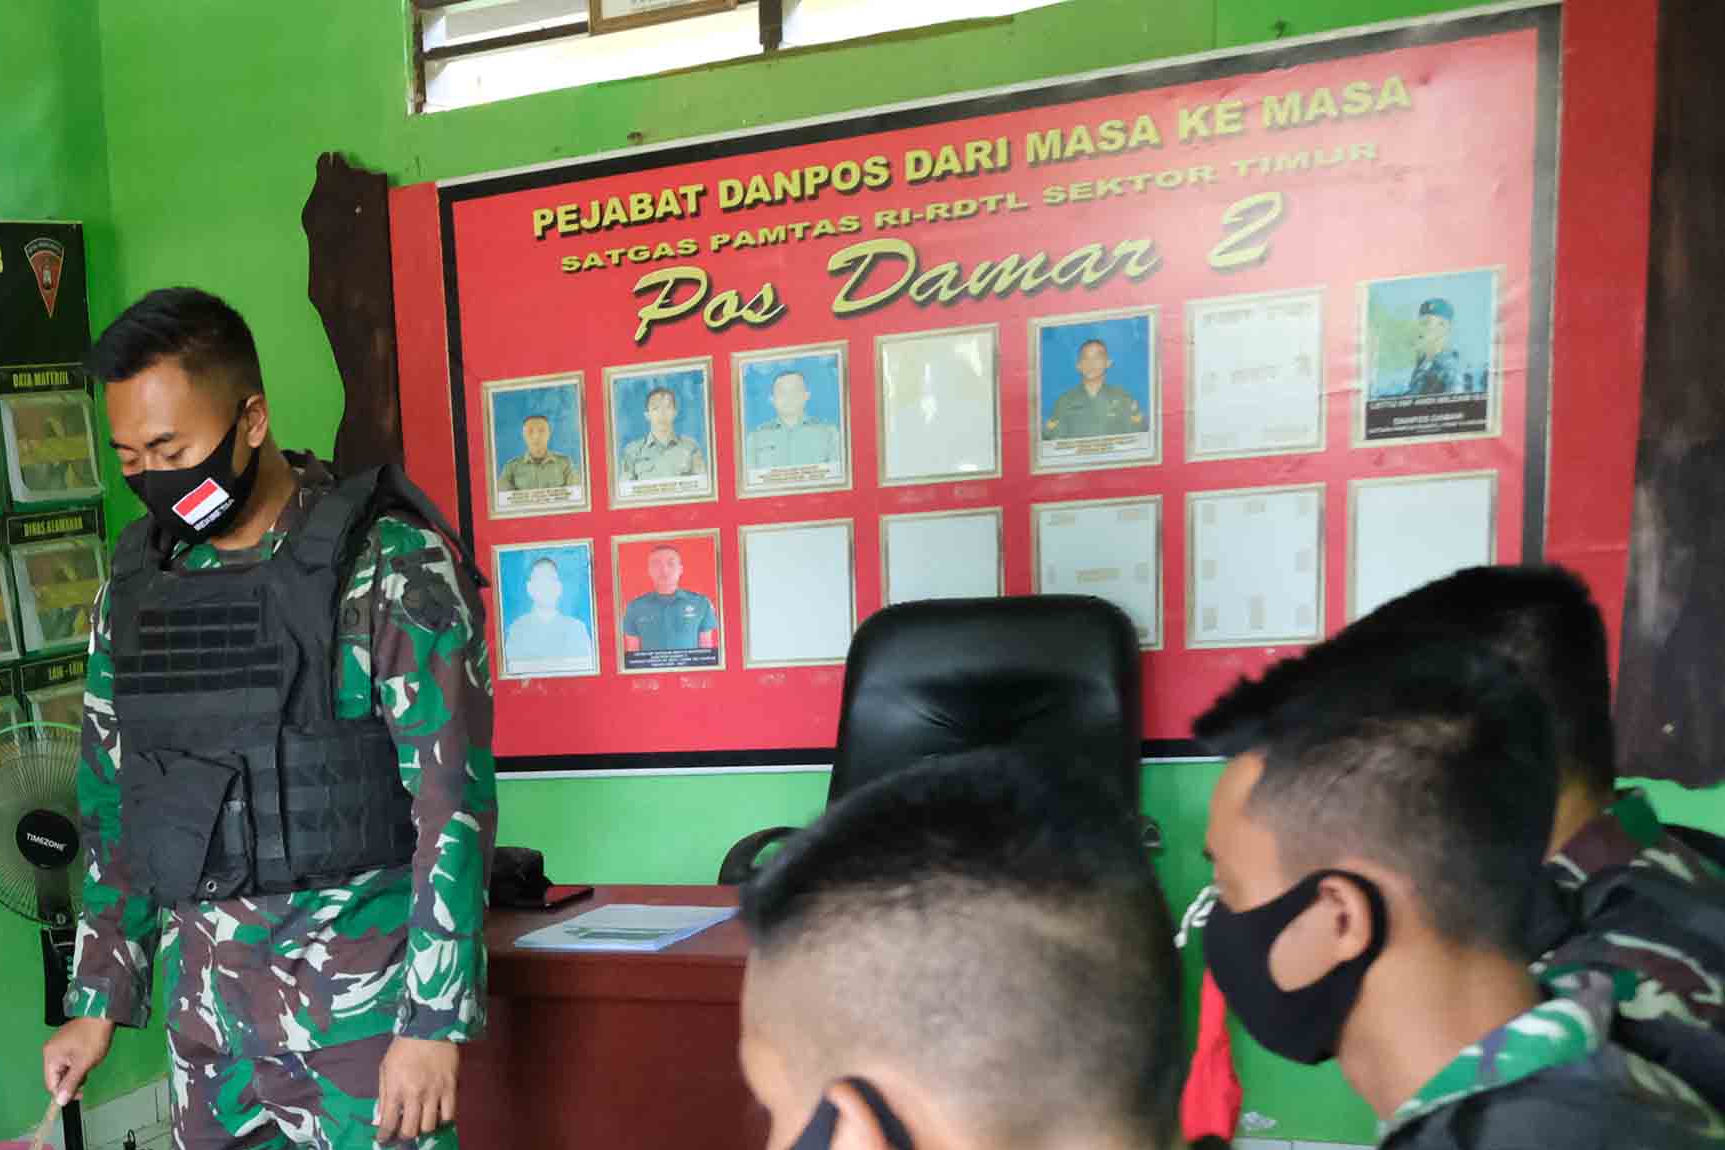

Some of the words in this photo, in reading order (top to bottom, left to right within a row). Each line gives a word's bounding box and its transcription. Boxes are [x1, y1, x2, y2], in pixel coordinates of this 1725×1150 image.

[532, 183, 705, 238] PEJABAT
[719, 156, 889, 211] DANPOS
[905, 136, 1009, 181] DARI
[1025, 115, 1162, 163] MASA
[1177, 99, 1244, 140] KE
[1262, 76, 1412, 127] MASA
[561, 238, 699, 272] SATGAS
[710, 215, 861, 251] PAMTAS
[874, 192, 1028, 228] RI-RDTL
[1042, 166, 1216, 203] SEKTOR
[1233, 143, 1379, 176] TIMUR
[632, 266, 785, 341] Pos
[827, 237, 1156, 313] Damar
[1208, 192, 1282, 267] 2
